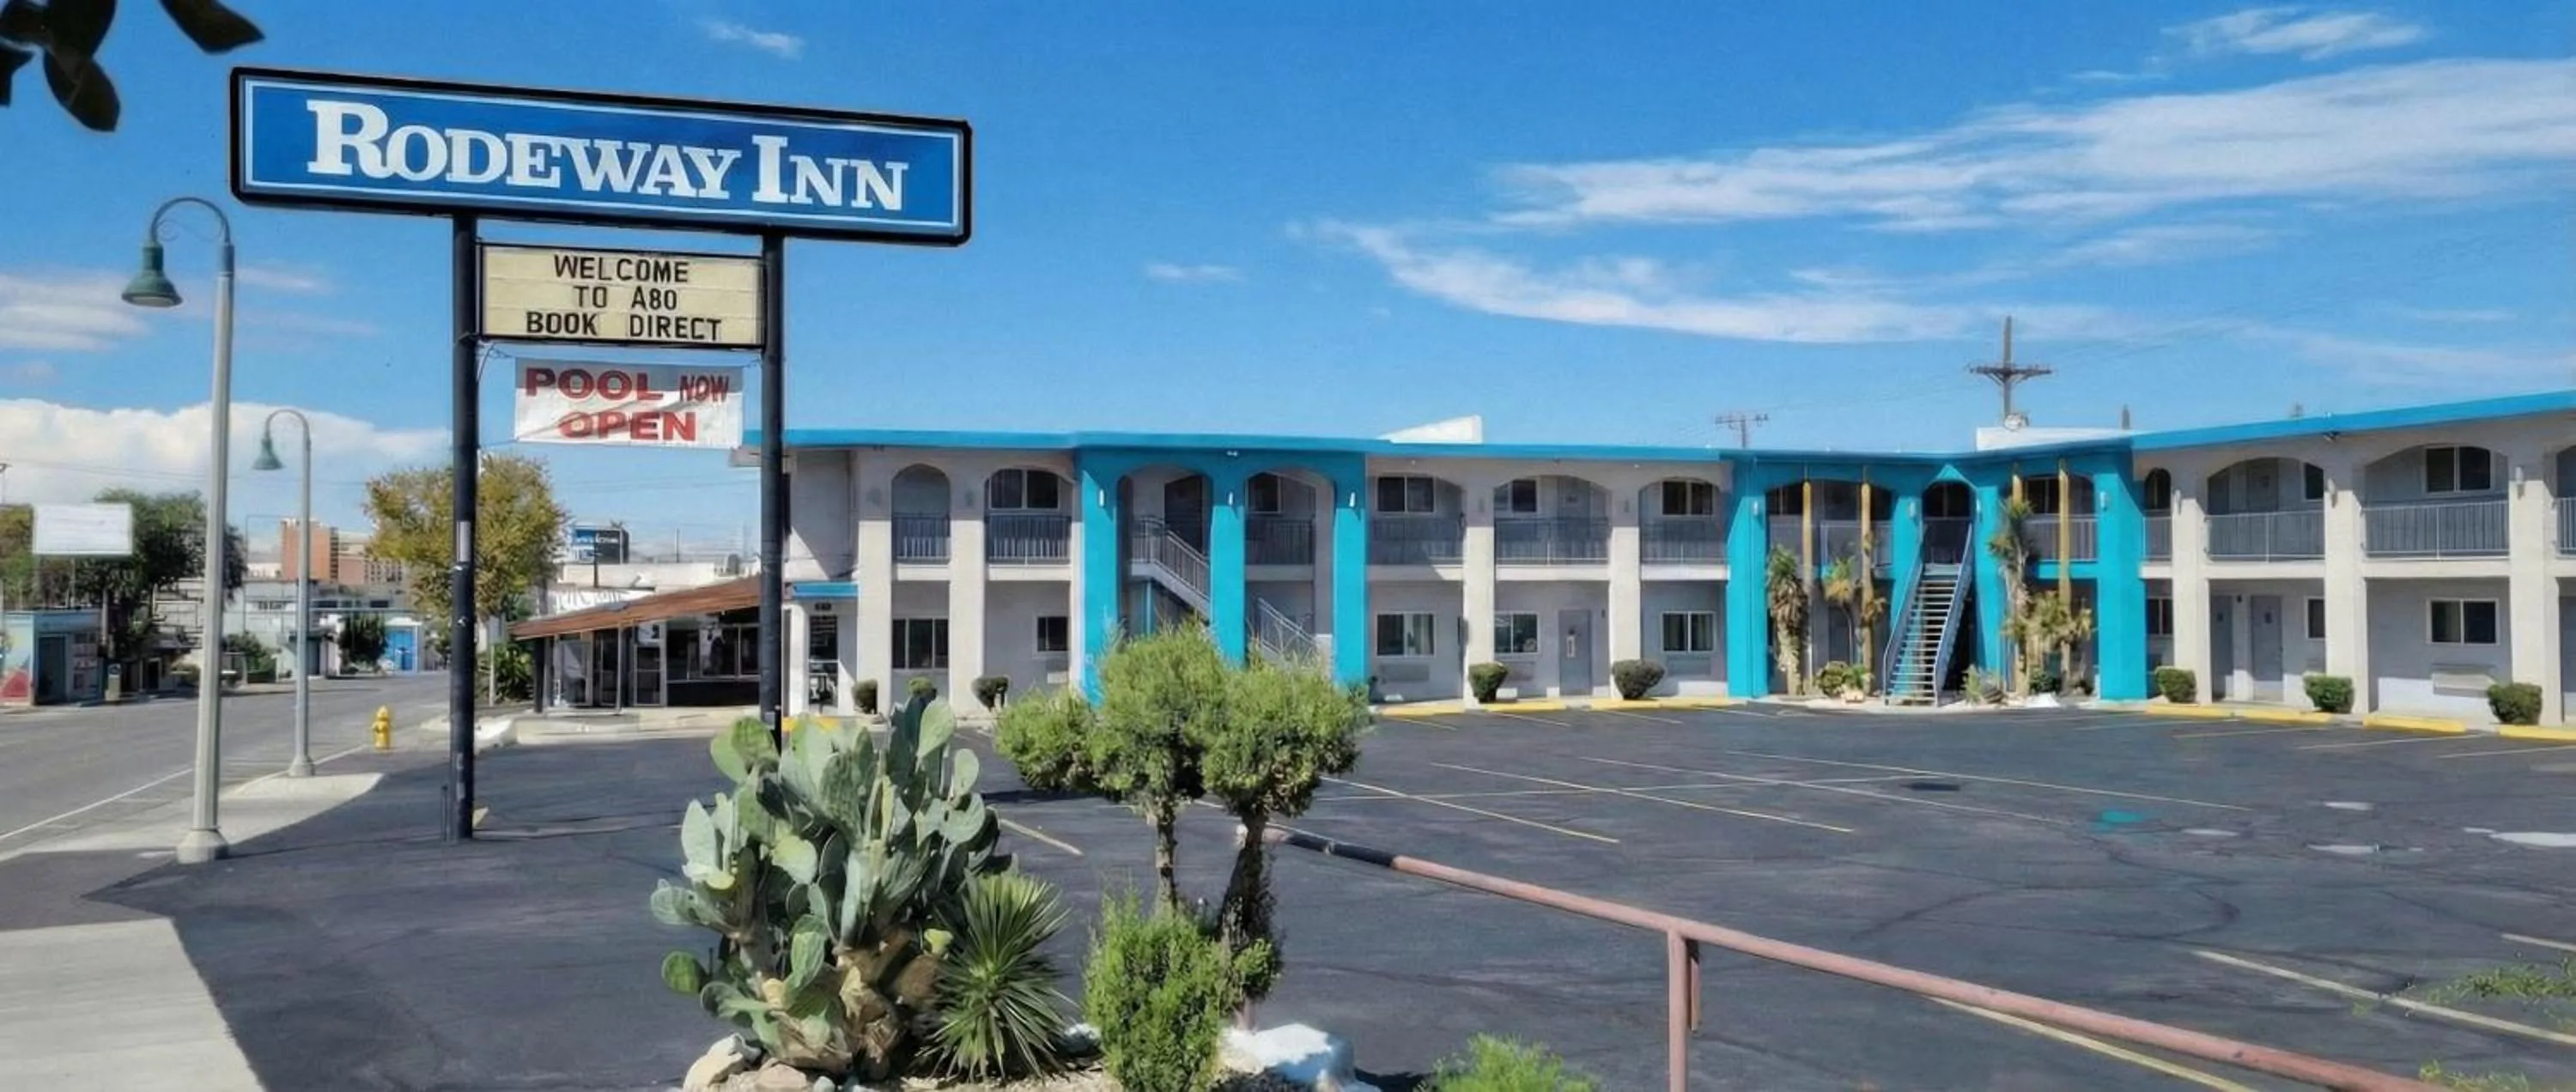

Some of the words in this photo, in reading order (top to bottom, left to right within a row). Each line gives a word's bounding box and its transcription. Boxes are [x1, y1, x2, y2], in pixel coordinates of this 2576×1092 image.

[306, 99, 742, 201] RODEWAY
[750, 134, 908, 212] INN
[554, 254, 690, 283] WELCOME
[573, 285, 608, 308] TO
[526, 311, 598, 336] BOOK
[629, 314, 722, 341] DIRECT
[525, 367, 664, 401] POOL
[678, 374, 730, 402] NOW
[558, 410, 697, 442] OPEN
